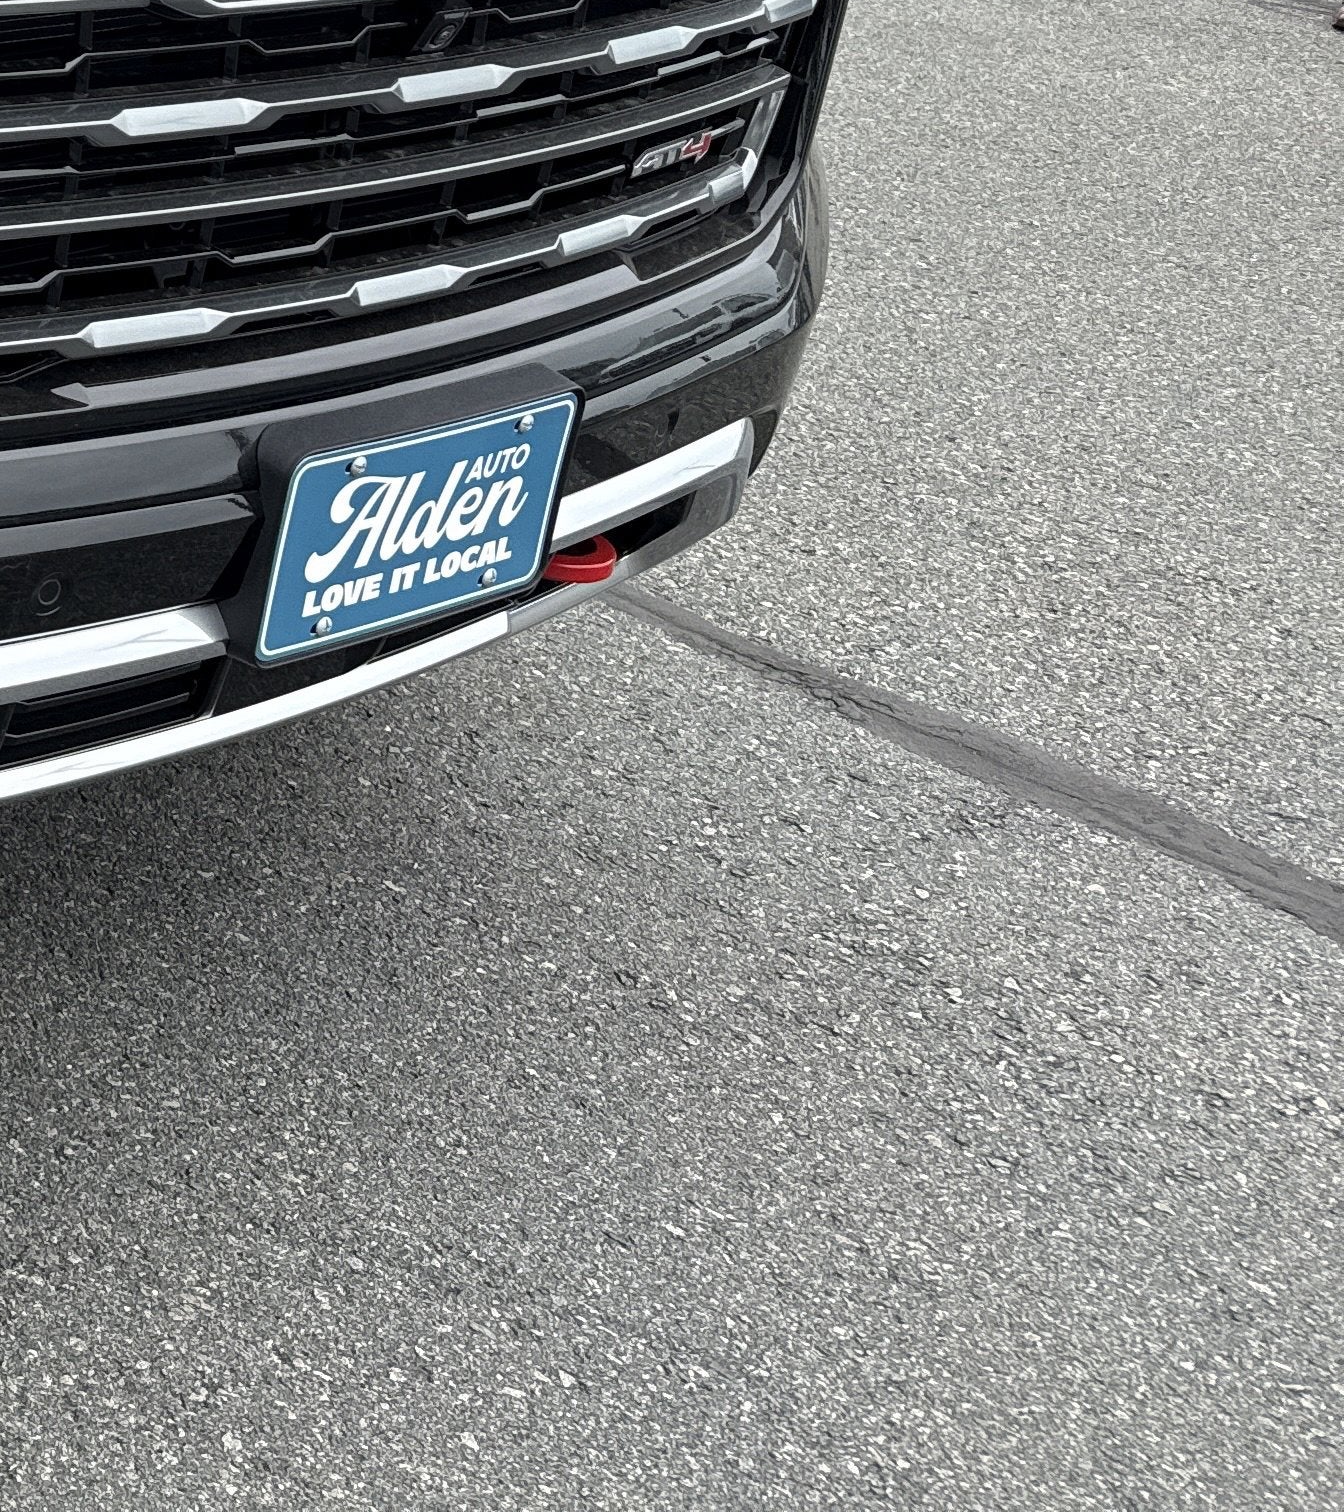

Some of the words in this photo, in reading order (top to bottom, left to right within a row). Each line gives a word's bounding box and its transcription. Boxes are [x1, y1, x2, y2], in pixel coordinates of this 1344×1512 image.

[630, 132, 712, 179] AT4
[464, 443, 531, 484] AUTO
[304, 460, 529, 583] Alden
[301, 572, 384, 617] LOVE
[388, 562, 421, 594] IT
[423, 536, 512, 584] LOCAL
